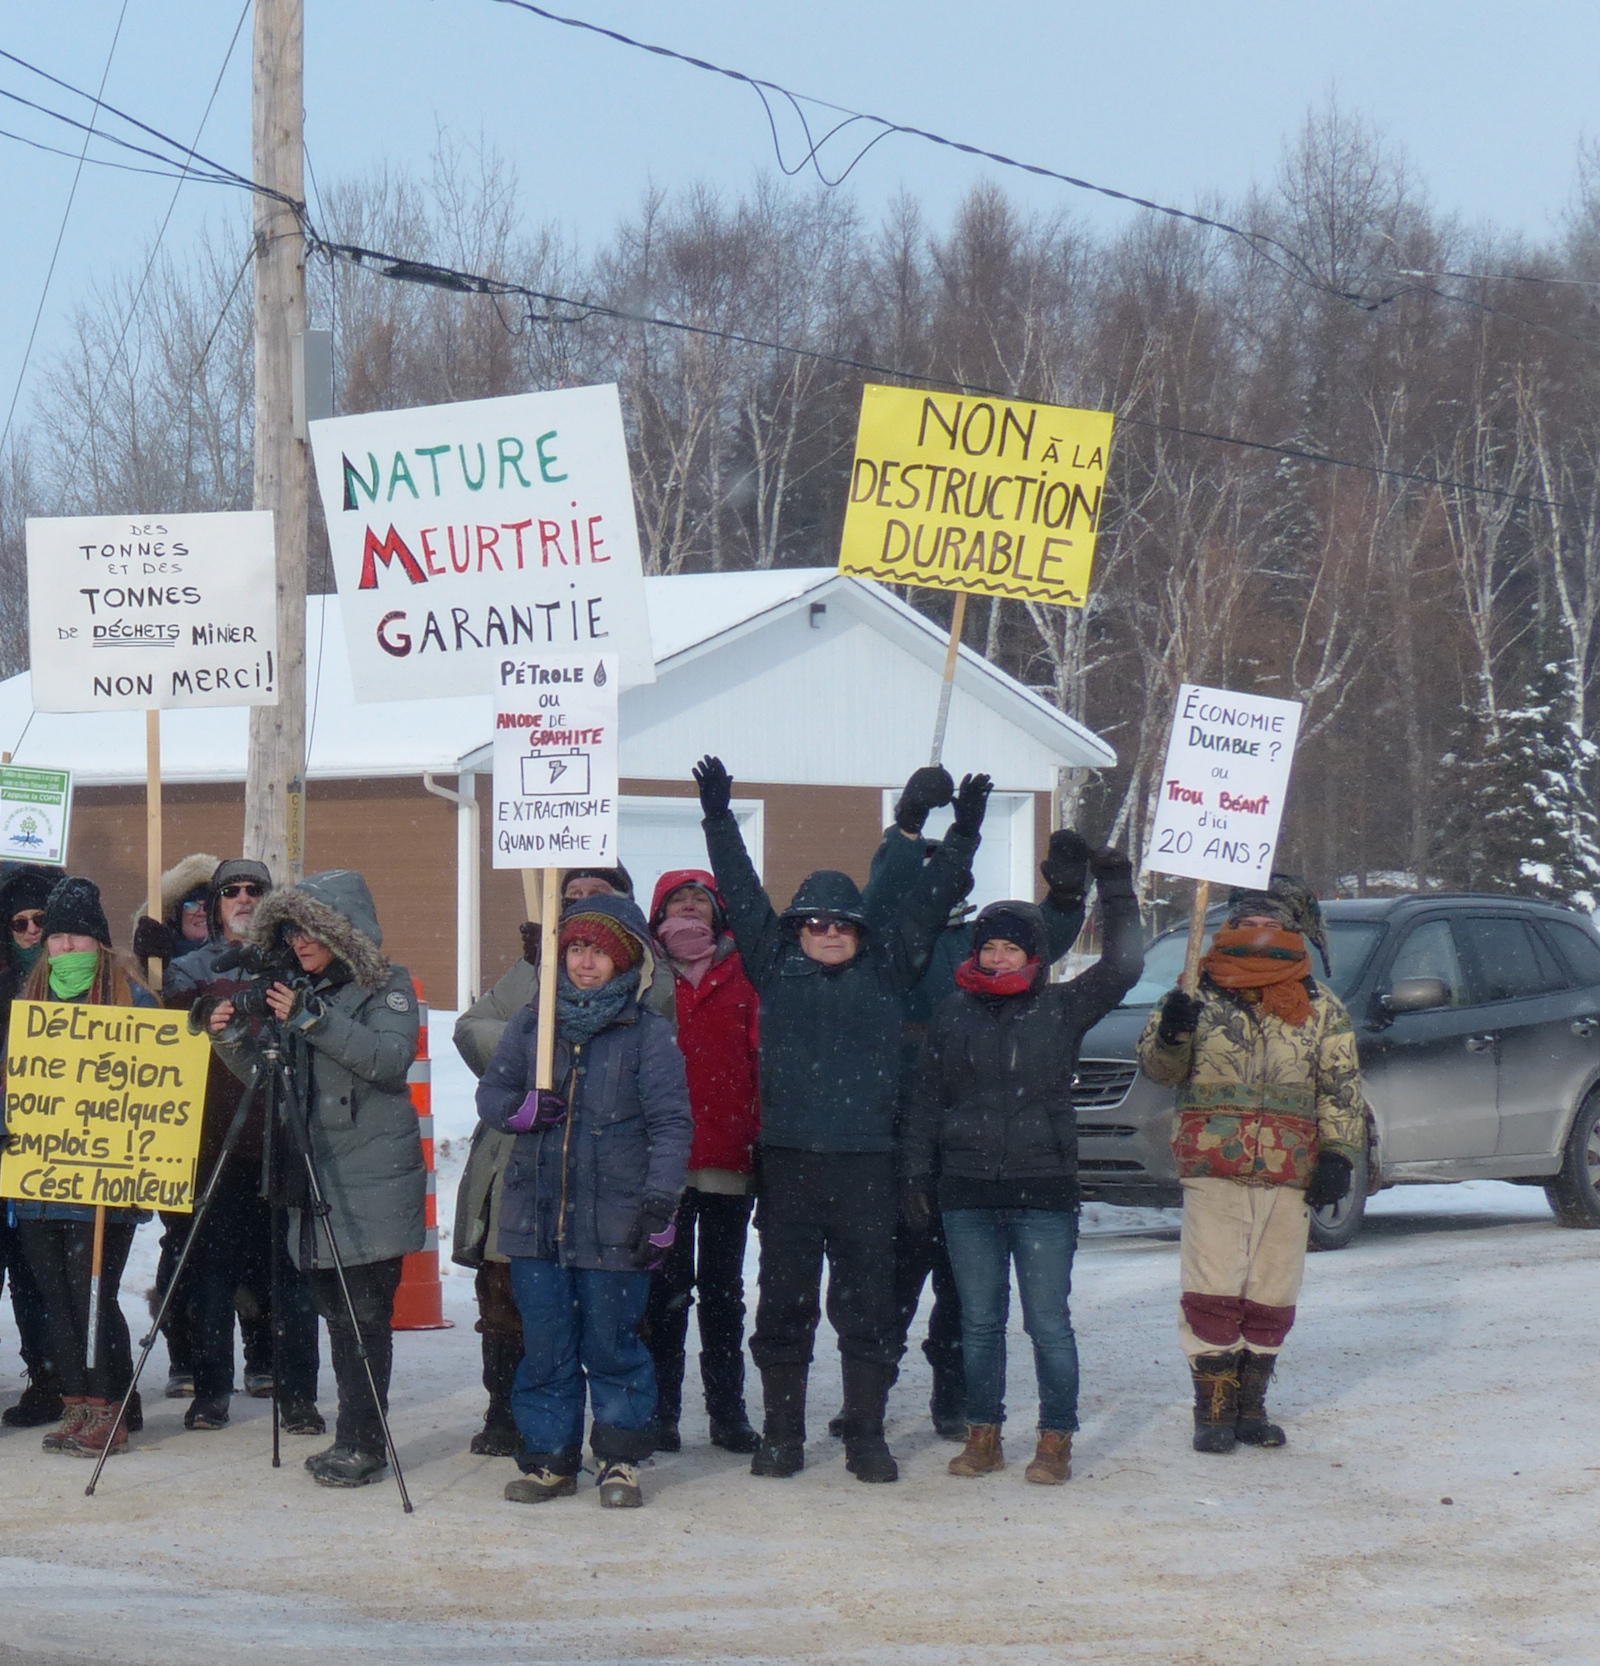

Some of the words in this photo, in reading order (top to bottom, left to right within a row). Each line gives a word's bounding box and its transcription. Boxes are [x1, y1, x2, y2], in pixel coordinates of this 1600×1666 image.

[918, 397, 1037, 461] NON
[1041, 437, 1063, 464] À
[1072, 444, 1103, 471] LA
[342, 430, 568, 512] NATURE
[851, 459, 1102, 533] DESTRUCTION
[129, 525, 168, 536] DES
[358, 501, 611, 590] MEURTRIE
[79, 543, 189, 560] TONNES
[880, 519, 1073, 585] DURABLE
[108, 564, 129, 575] ET
[143, 563, 183, 575] DES
[80, 587, 201, 615] TONNES
[93, 618, 180, 640] DÉCHETS
[376, 583, 609, 657] GARANTIE
[94, 674, 153, 697] NON
[497, 713, 543, 729] ANODE
[550, 714, 567, 728] DE
[1183, 689, 1285, 733] ÉCONOMIE
[530, 727, 604, 747] GRAPHITE
[498, 799, 611, 822] EXTRACTIVISME
[1198, 811, 1227, 829] d'ici
[498, 830, 545, 854] QUAND
[550, 826, 591, 850] MÊME
[1158, 829, 1192, 854] 20
[27, 1005, 180, 1046] Détruire
[7, 1055, 66, 1079] une
[76, 1052, 183, 1091] région
[7, 1093, 65, 1123] pour
[75, 1092, 191, 1131] quelques
[8, 1129, 110, 1162] emplois
[20, 1166, 84, 1199] C'est
